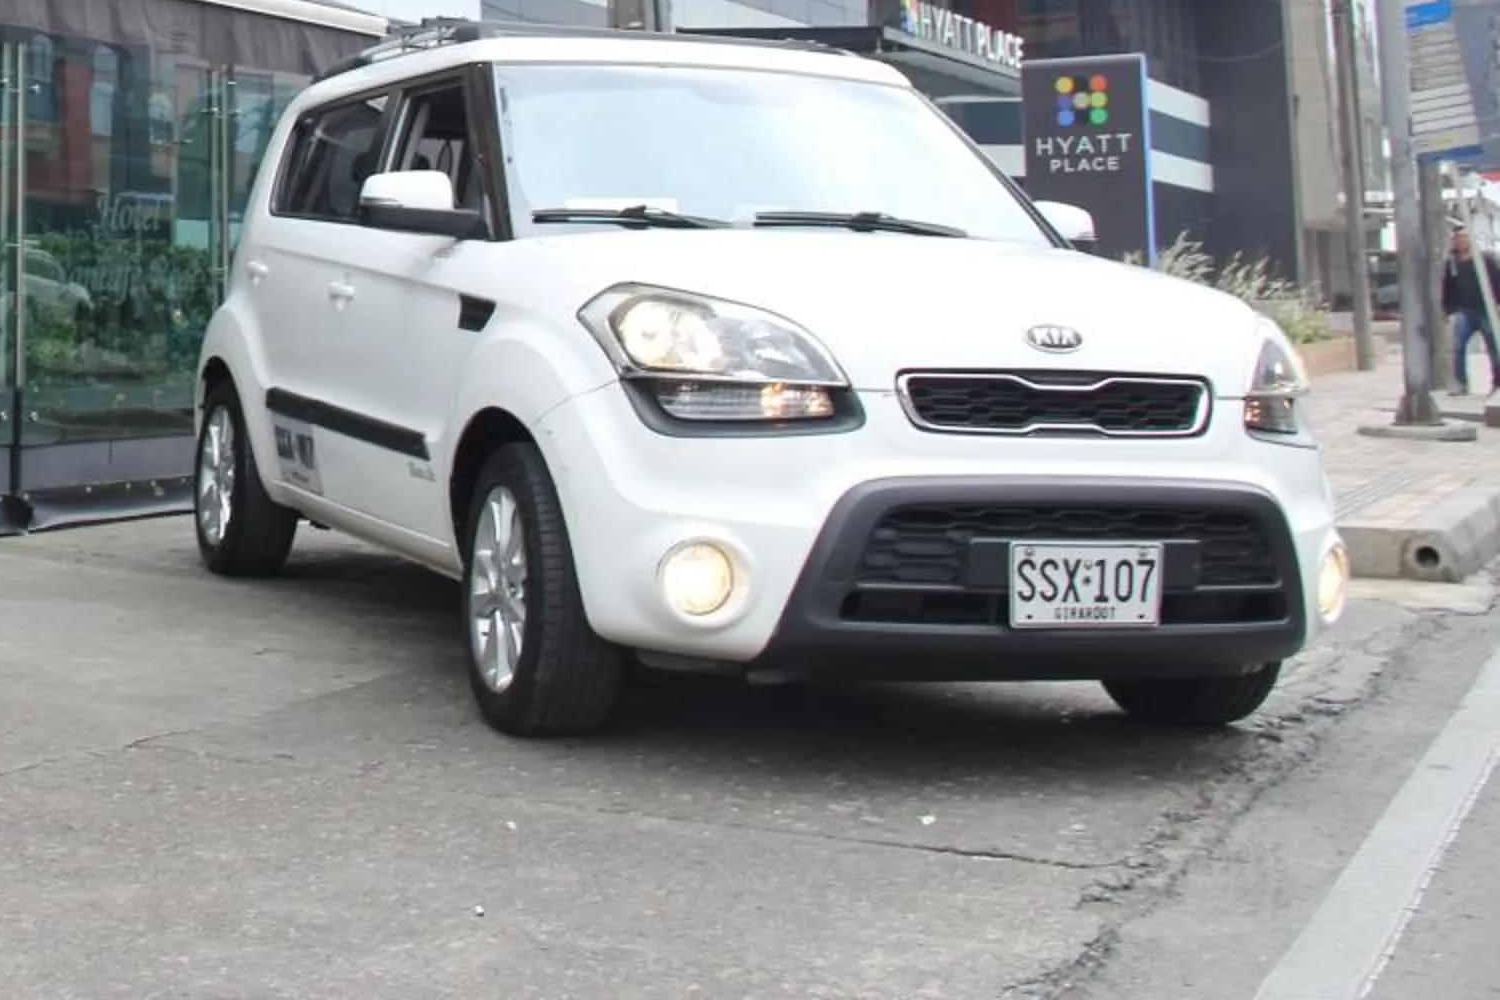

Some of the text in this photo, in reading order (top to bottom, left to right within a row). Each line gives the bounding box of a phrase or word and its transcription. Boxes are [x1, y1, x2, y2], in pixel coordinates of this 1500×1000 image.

[920, 1, 1024, 69] HYATT PLACE
[1035, 133, 1132, 156] HYATT
[1051, 157, 1120, 173] PLACE
[1030, 326, 1079, 346] KIA
